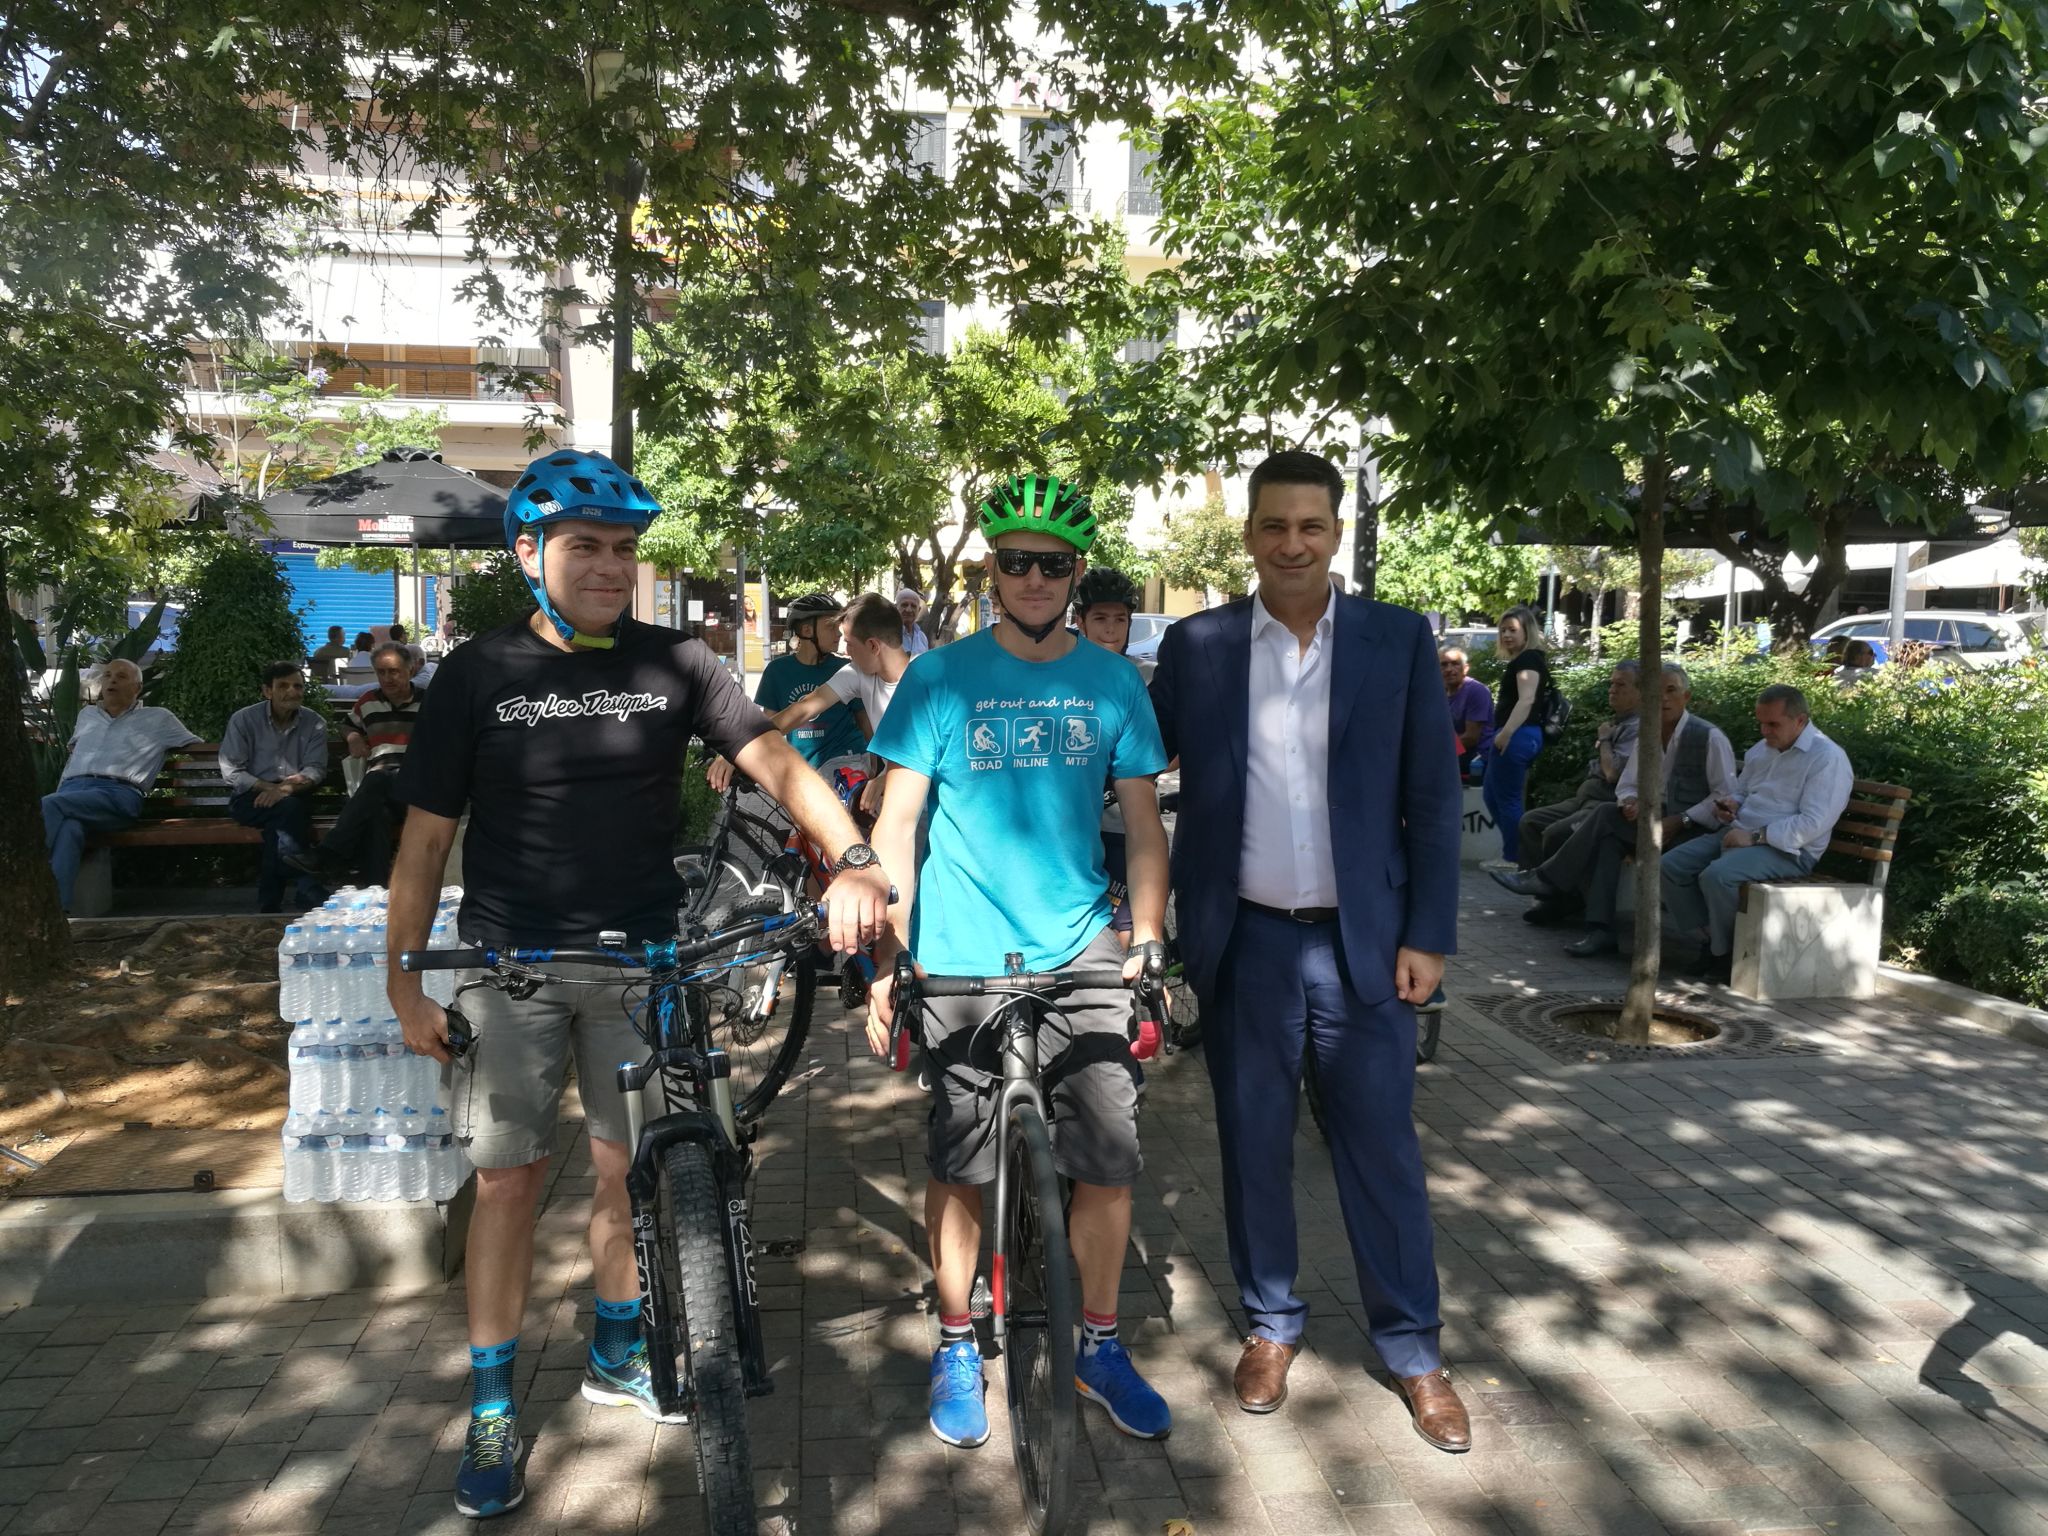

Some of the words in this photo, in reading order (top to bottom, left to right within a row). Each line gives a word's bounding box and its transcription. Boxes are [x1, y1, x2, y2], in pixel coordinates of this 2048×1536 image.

[496, 695, 542, 727] Troy
[542, 693, 583, 718] Lee
[582, 689, 668, 722] Designs
[975, 697, 998, 712] get
[1000, 697, 1026, 709] out
[1028, 696, 1060, 708] and
[1063, 696, 1095, 711] play
[970, 760, 1003, 771] ROAD
[1013, 757, 1049, 769] INLINE
[1065, 756, 1088, 766] MTB
